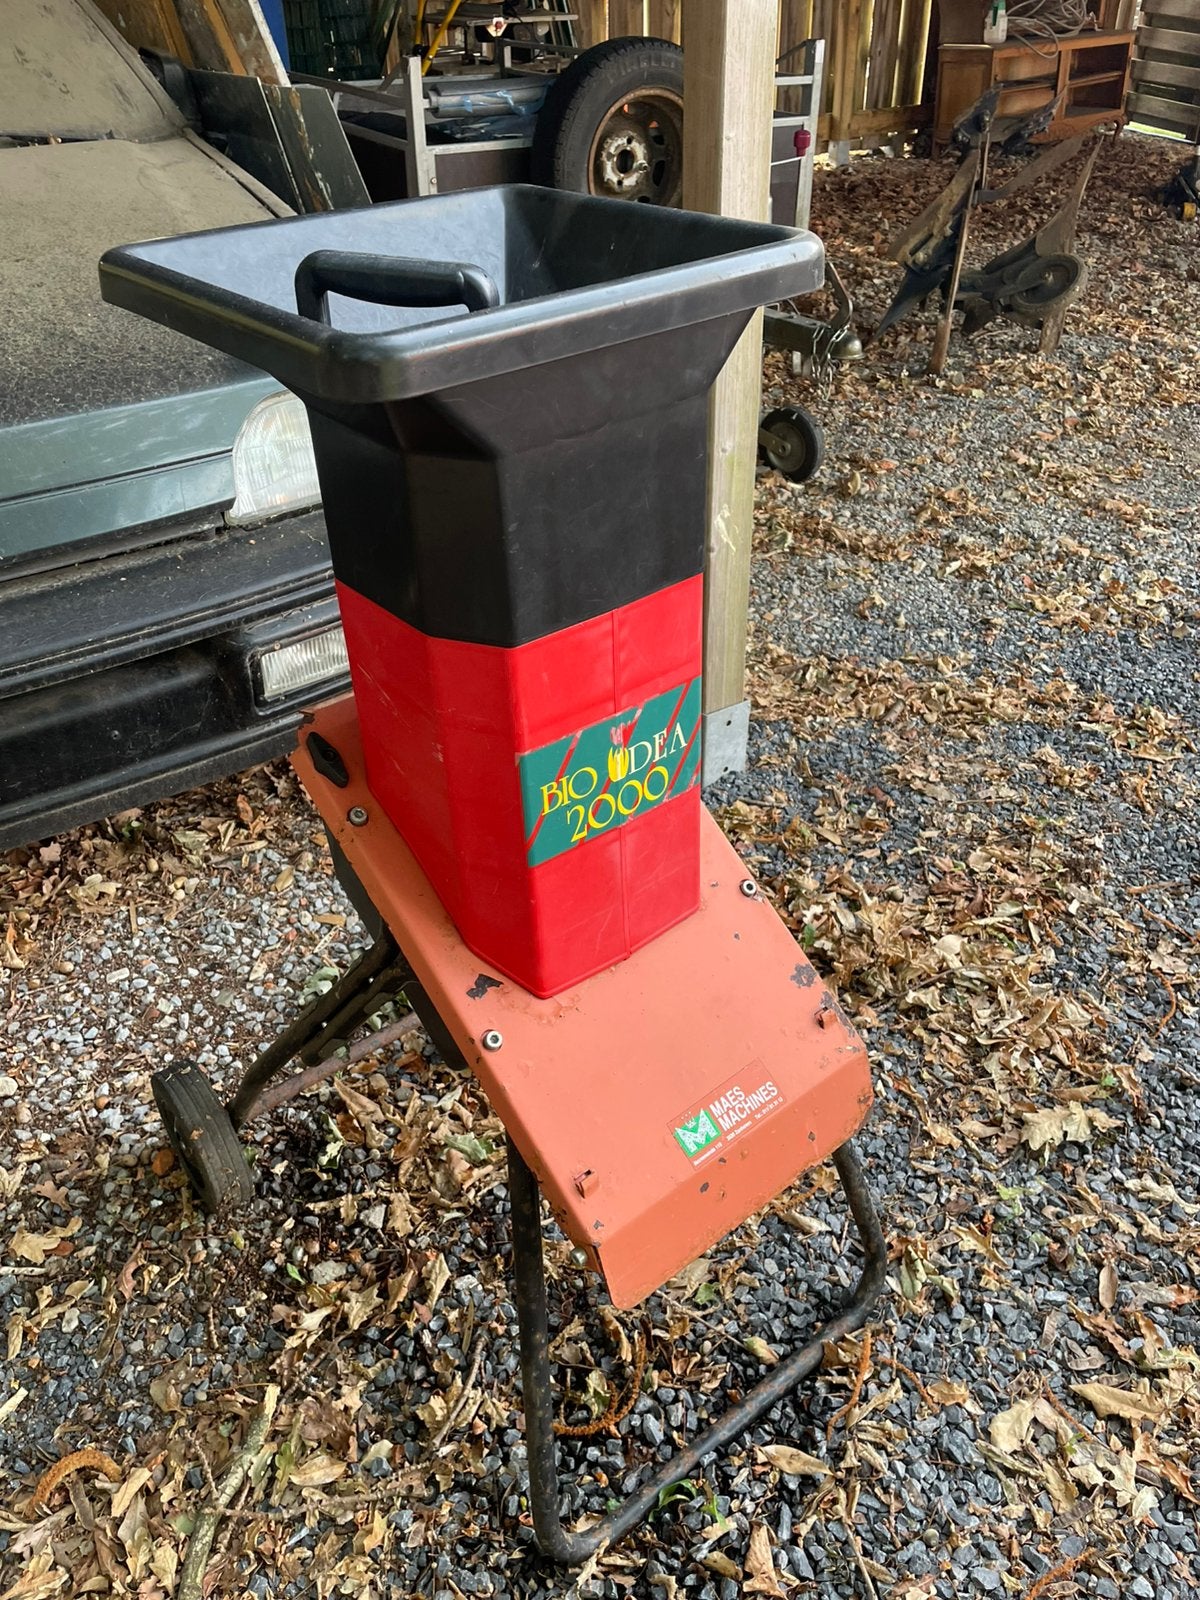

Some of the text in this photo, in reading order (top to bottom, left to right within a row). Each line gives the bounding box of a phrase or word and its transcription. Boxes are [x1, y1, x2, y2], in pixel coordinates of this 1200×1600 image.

[540, 766, 598, 816] BIO
[566, 765, 669, 843] 2000
[708, 1085, 746, 1118] MAES
[717, 1080, 778, 1131] MACHINES
